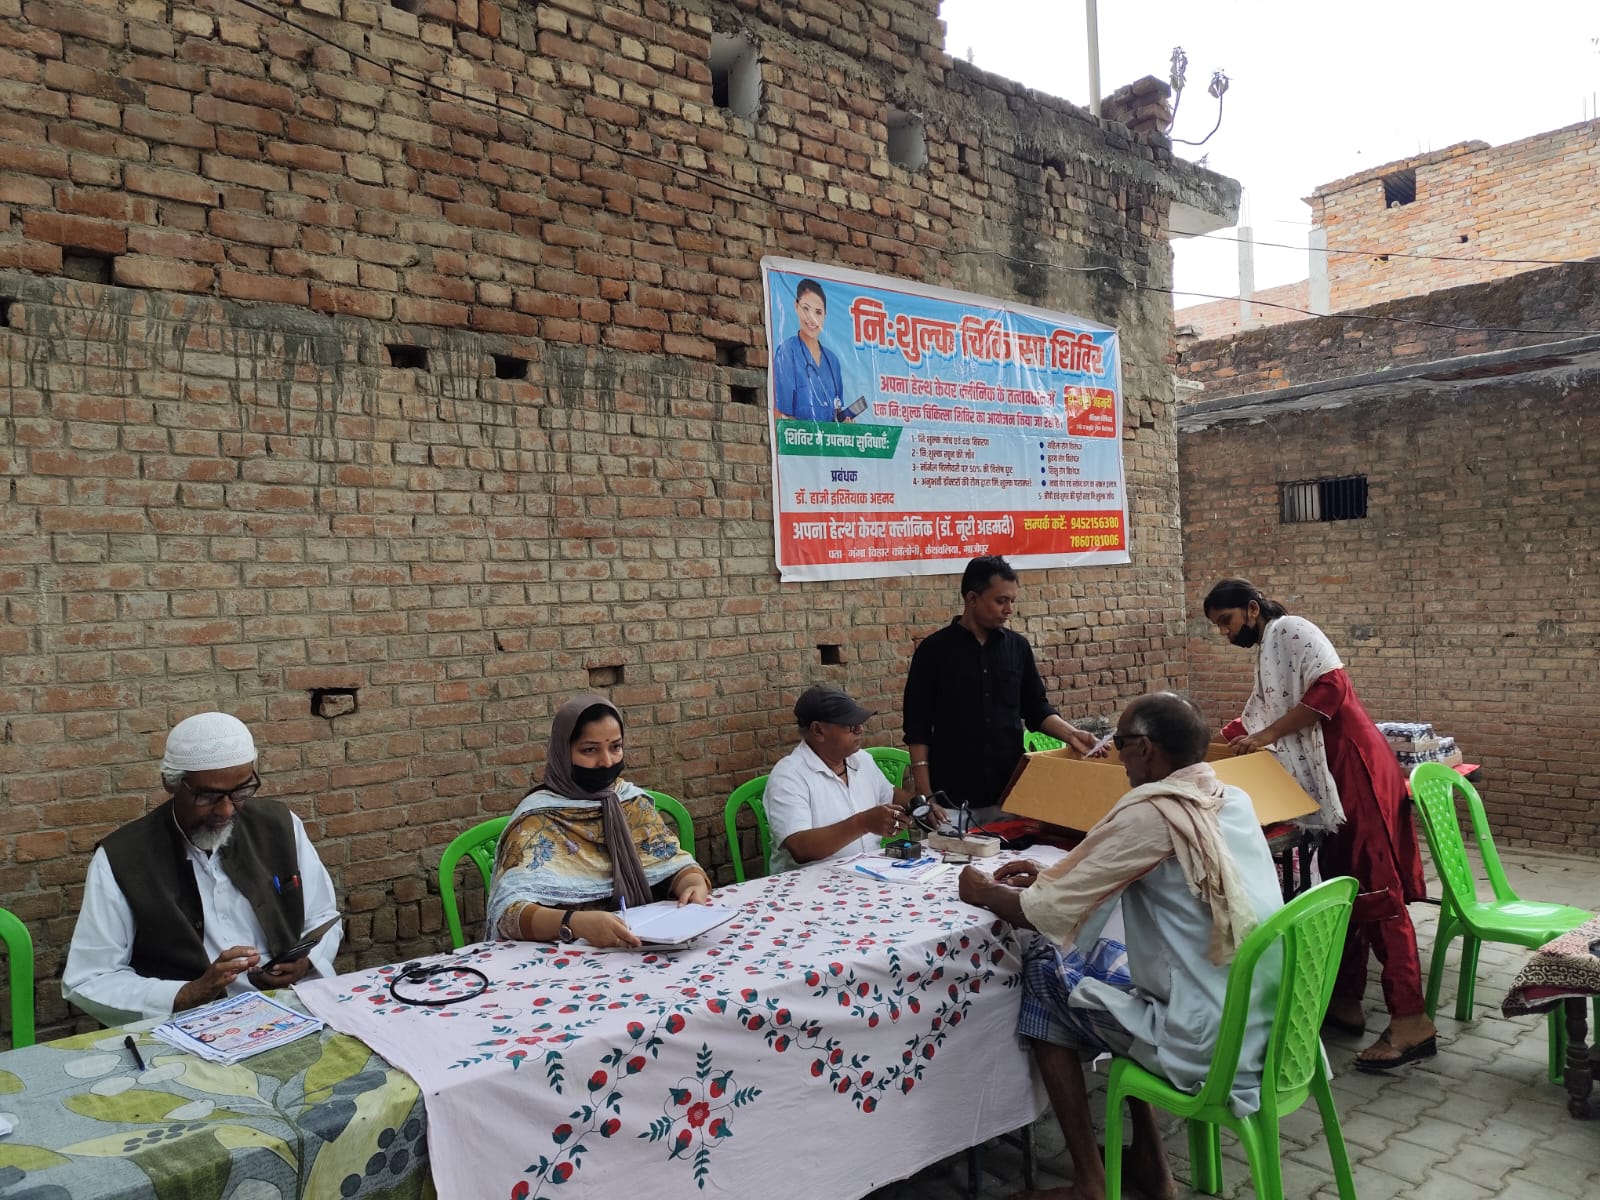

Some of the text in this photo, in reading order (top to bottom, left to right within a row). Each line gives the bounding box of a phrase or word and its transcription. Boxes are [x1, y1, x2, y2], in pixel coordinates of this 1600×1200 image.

[851, 298, 956, 361] नि:शुल्क
[1051, 329, 1104, 373] शिविर
[880, 376, 908, 393] अपना
[911, 375, 932, 397] हेल्थ
[935, 377, 956, 398] केयर
[997, 384, 1004, 402] के
[873, 403, 887, 416] एक
[889, 402, 921, 423] नि:शुल्क
[923, 404, 951, 421] चिकित्सा
[954, 407, 974, 423] शिविर
[976, 412, 986, 424] का
[988, 409, 1015, 426] आयोजन
[1034, 416, 1042, 427] जा
[784, 428, 813, 446] शिविर
[815, 431, 824, 446] में
[825, 433, 854, 447] उपलब्ध
[831, 467, 858, 482] प्रबंधक
[969, 465, 981, 473] 50%
[795, 488, 895, 505] डॉ. हाजी इश्तियाक अहमद
[793, 514, 1015, 541] अपना हेल्थ केयर क्लीनिक (डॉ. नूरी अहमदी)
[1023, 515, 1119, 530] सम्पर्क करें: 9452156380
[1070, 534, 1119, 548] 7860781006
[869, 547, 889, 557] विहार
